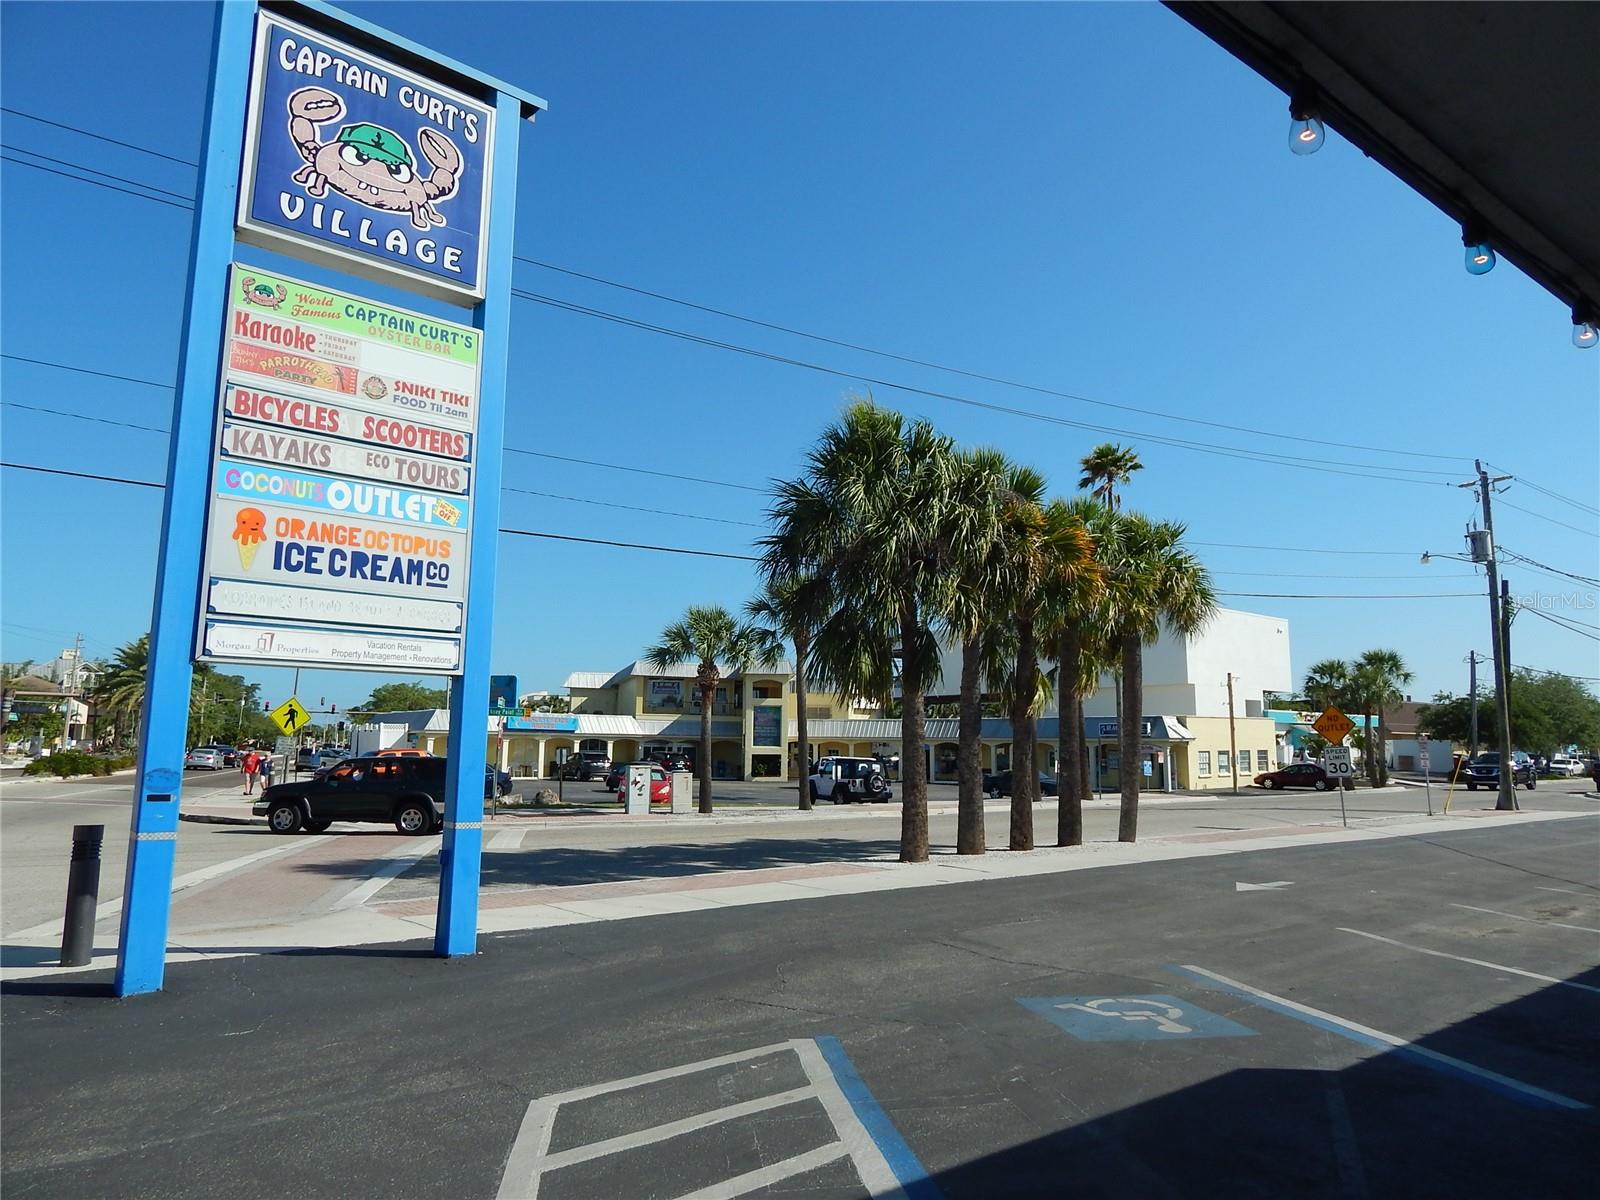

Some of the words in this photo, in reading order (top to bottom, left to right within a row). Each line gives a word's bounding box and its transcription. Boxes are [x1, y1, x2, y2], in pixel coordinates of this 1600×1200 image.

[279, 38, 387, 98] CAPTAIN
[399, 86, 478, 143] CURT'S
[279, 192, 462, 273] VILLAGE
[291, 304, 341, 320] Famous
[296, 293, 334, 306] World
[234, 311, 316, 352] Karaoke
[345, 304, 415, 334] CAPTAIN
[420, 324, 473, 349] CURT'S
[324, 341, 346, 351] FRIDAY
[368, 326, 420, 347] OYSTER
[425, 341, 451, 355] BAR
[274, 368, 317, 385] PARTY
[393, 394, 427, 409] FOOD
[430, 402, 442, 413] Til
[445, 406, 468, 418] 2am
[394, 380, 435, 400] SNIKI
[440, 390, 469, 407] TIKI
[234, 389, 340, 433] BICYCLES
[362, 416, 464, 457] SCOOTERS
[232, 429, 331, 468] KAYAKS
[366, 452, 390, 470] ECO
[394, 457, 460, 490] TOURS
[225, 468, 325, 501] COCONUTS
[326, 481, 438, 523] OUTLET
[275, 516, 363, 547] ORANGE
[363, 529, 451, 559] OCTOPUS
[273, 541, 326, 575] ICE
[328, 547, 425, 585] CREAM
[426, 560, 450, 582] CO
[215, 640, 251, 650] Morgan
[277, 643, 319, 655] Properties
[331, 648, 361, 659] Property
[363, 650, 407, 661] Management
[412, 654, 452, 664] Renovations
[367, 641, 396, 650] Vacation
[397, 642, 422, 652] Rentals
[1318, 723, 1350, 732] OUTLET
[1329, 762, 1349, 774] 30
